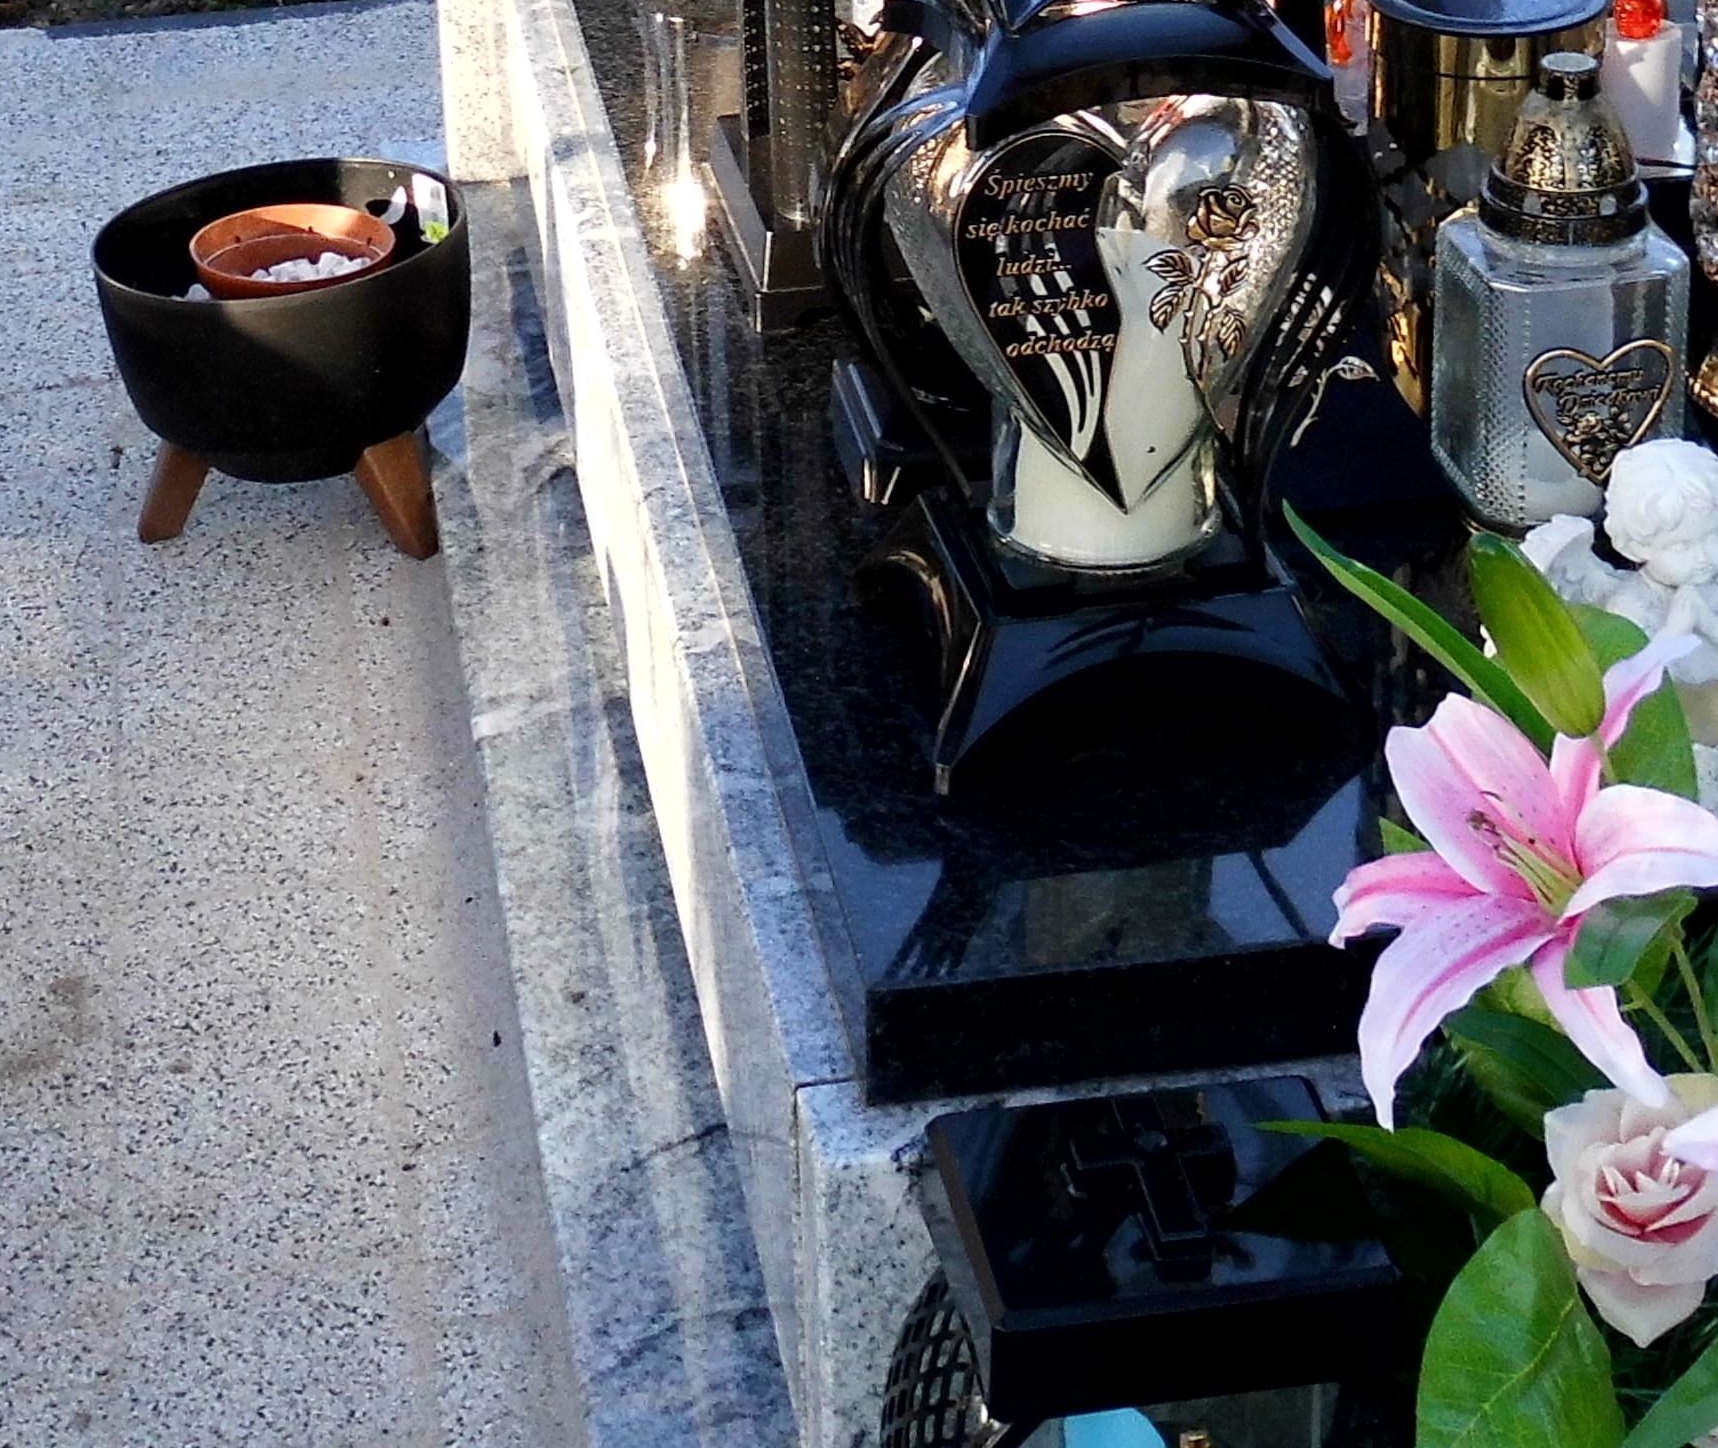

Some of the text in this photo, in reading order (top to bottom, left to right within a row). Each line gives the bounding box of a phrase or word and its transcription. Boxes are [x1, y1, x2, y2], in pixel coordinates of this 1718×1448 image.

[984, 169, 1094, 200] Śpieszmy
[966, 207, 1091, 242] się kochać
[989, 289, 1109, 319] tak szybko
[1006, 329, 1116, 358] odchodzą
